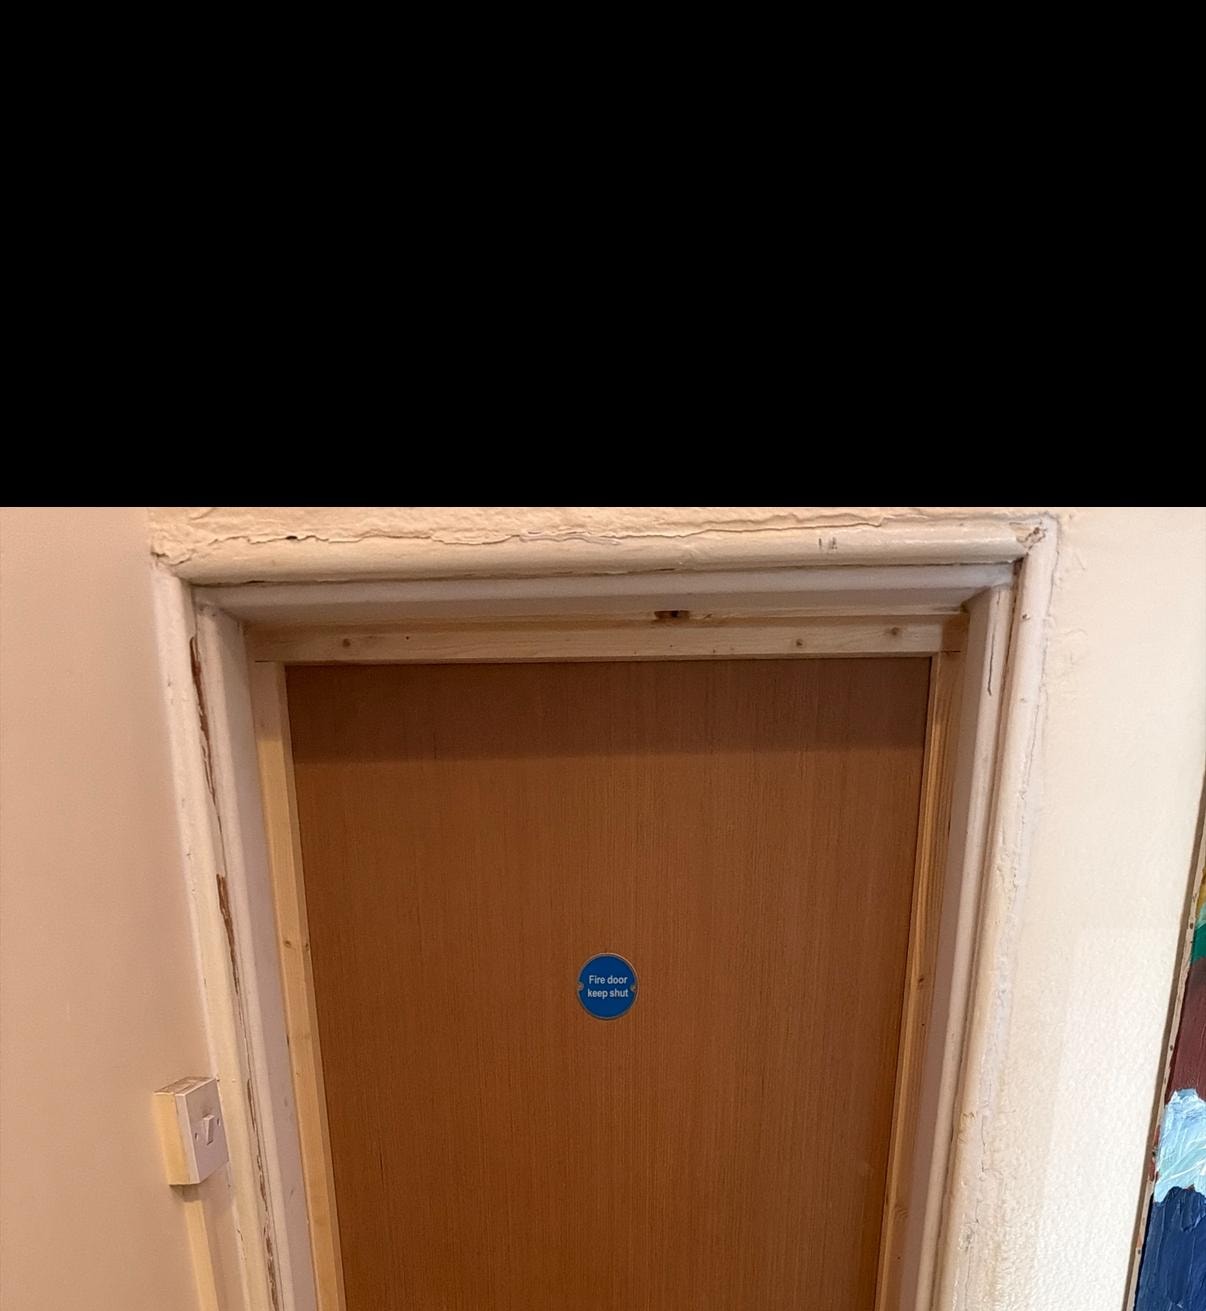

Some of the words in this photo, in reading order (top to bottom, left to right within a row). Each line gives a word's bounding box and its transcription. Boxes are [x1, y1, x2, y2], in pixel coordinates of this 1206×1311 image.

[588, 975, 606, 984] Fire
[607, 975, 628, 984] door
[587, 988, 608, 999] keep
[609, 988, 628, 997] shut
